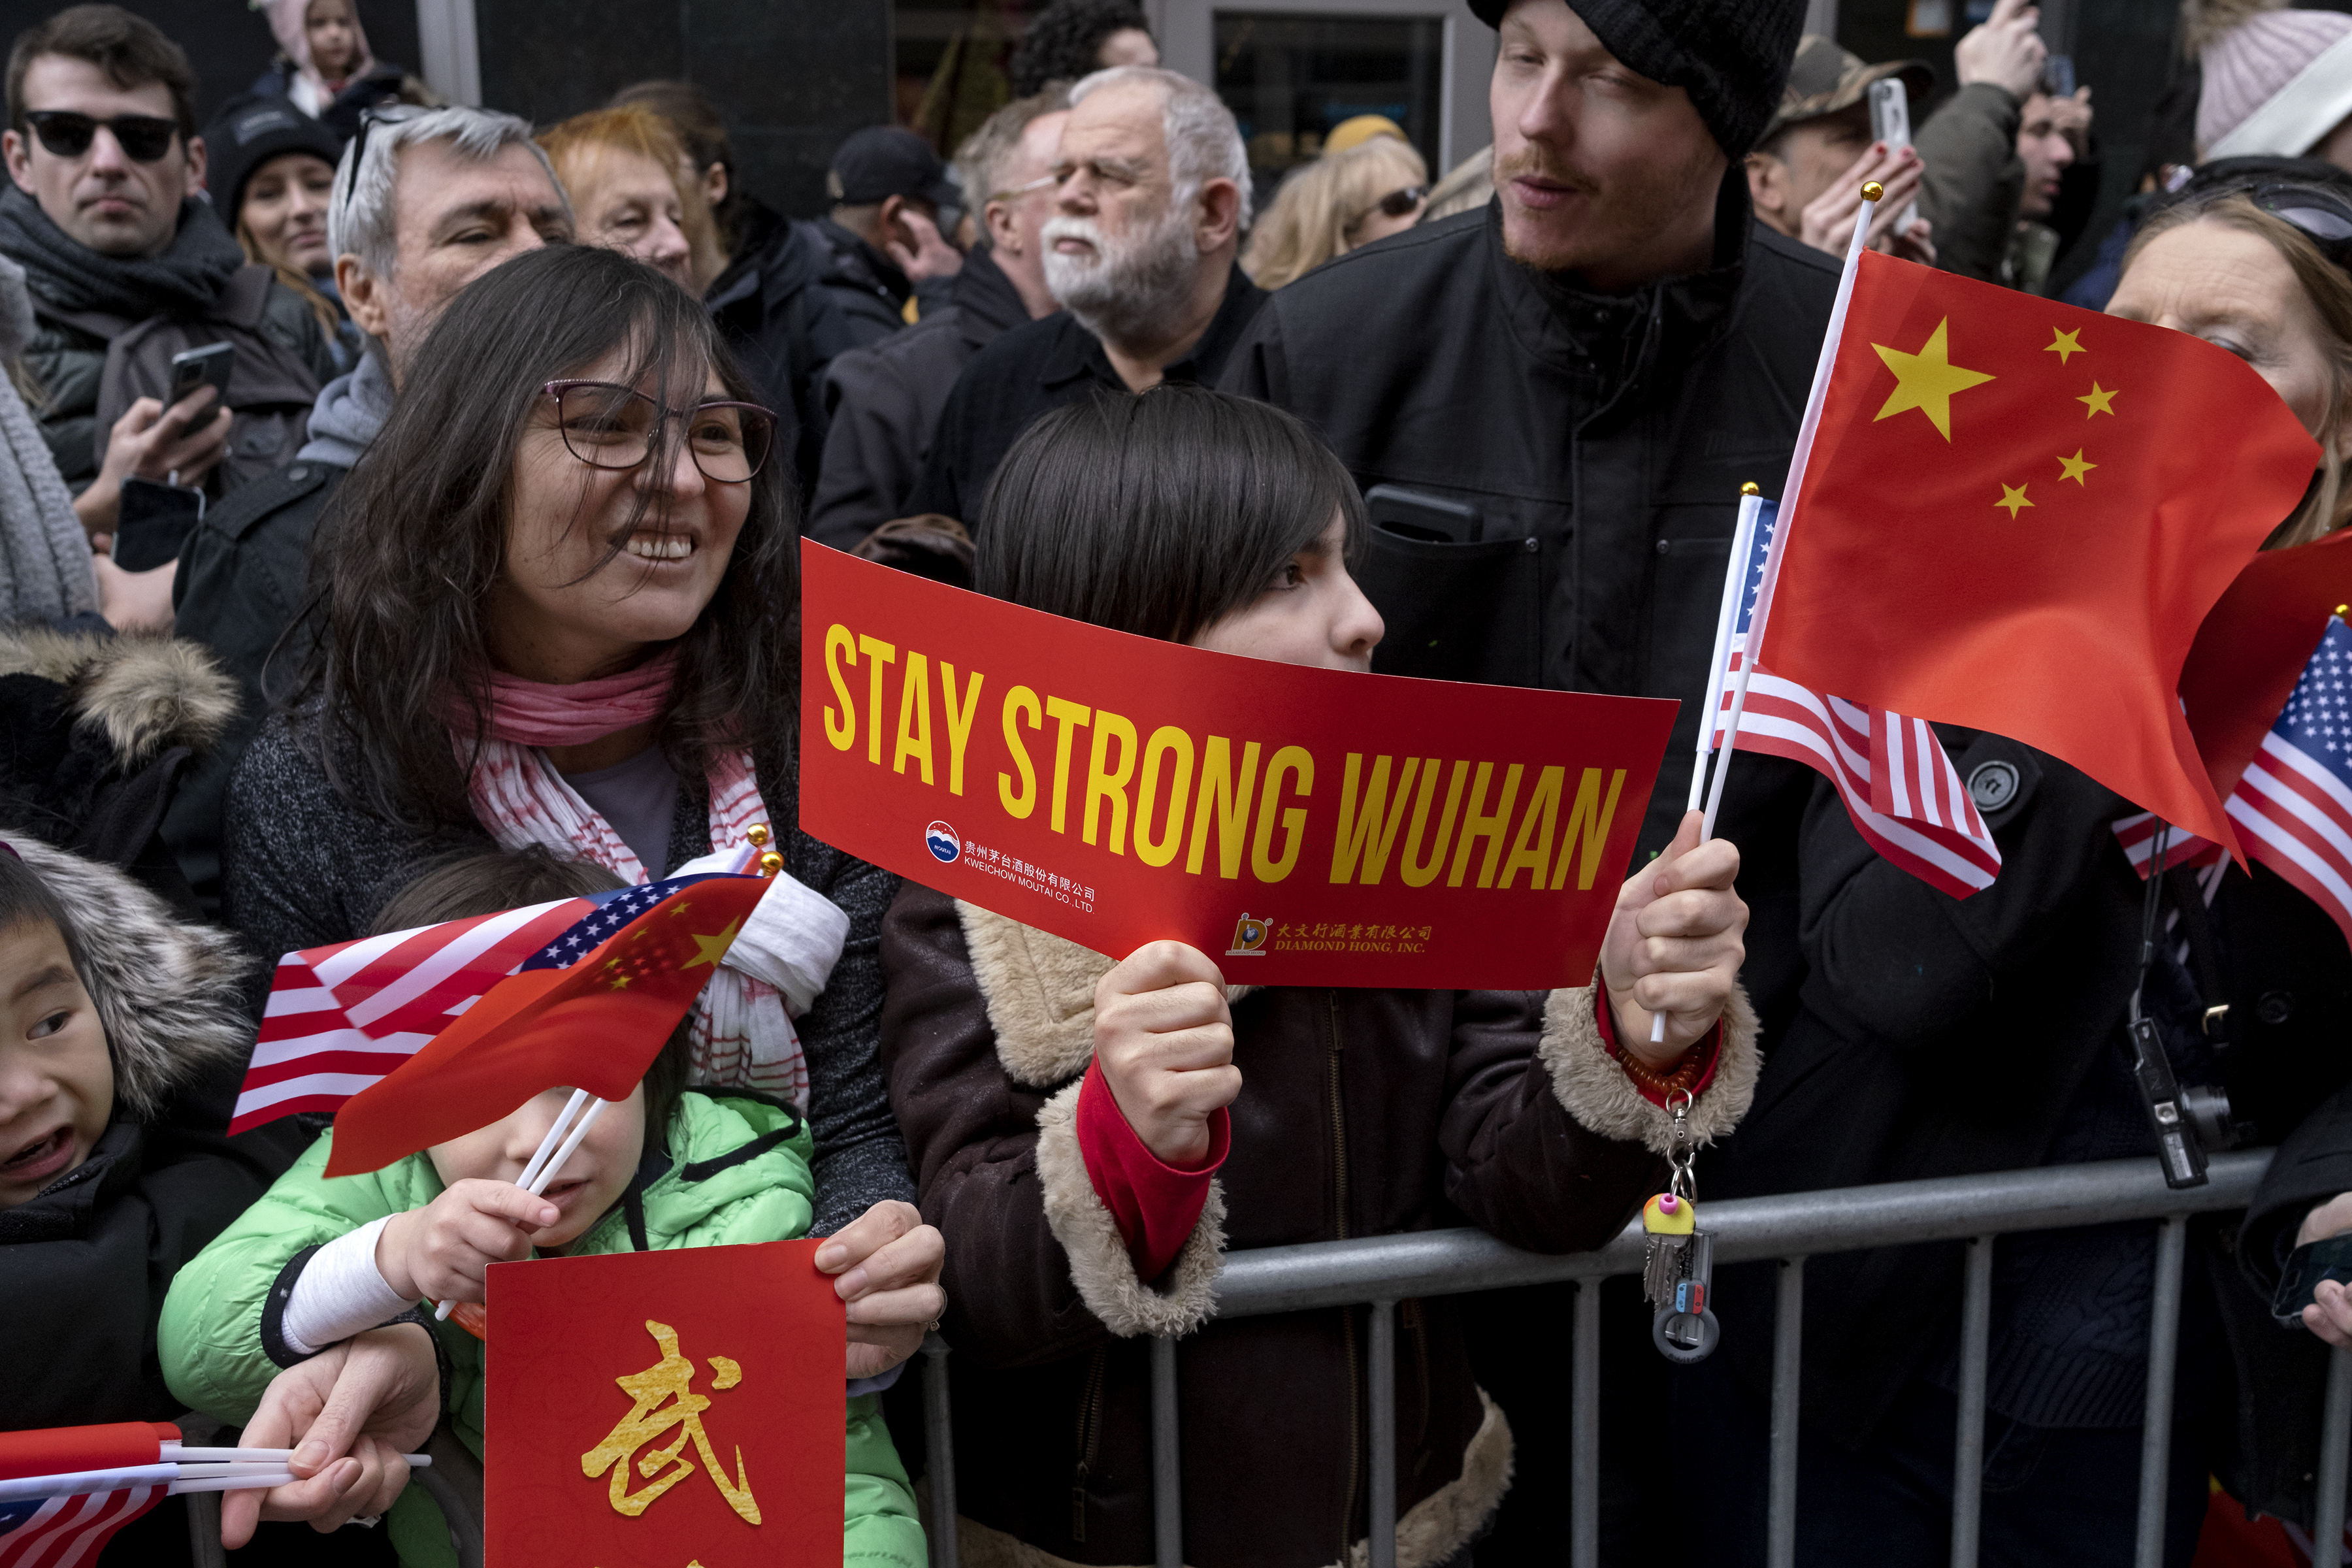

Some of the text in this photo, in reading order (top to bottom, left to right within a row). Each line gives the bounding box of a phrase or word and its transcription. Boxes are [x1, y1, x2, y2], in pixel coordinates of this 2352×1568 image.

[824, 623, 1627, 890] STAY STRONG WUHAN
[934, 844, 951, 855] MOUTAI
[964, 840, 1094, 902] 贵州茅台酒股份有限公司
[964, 856, 1017, 883] KWEICHOW
[1018, 875, 1053, 898] MOUTAI
[1275, 940, 1425, 954] DIAMOND HONG, INC.
